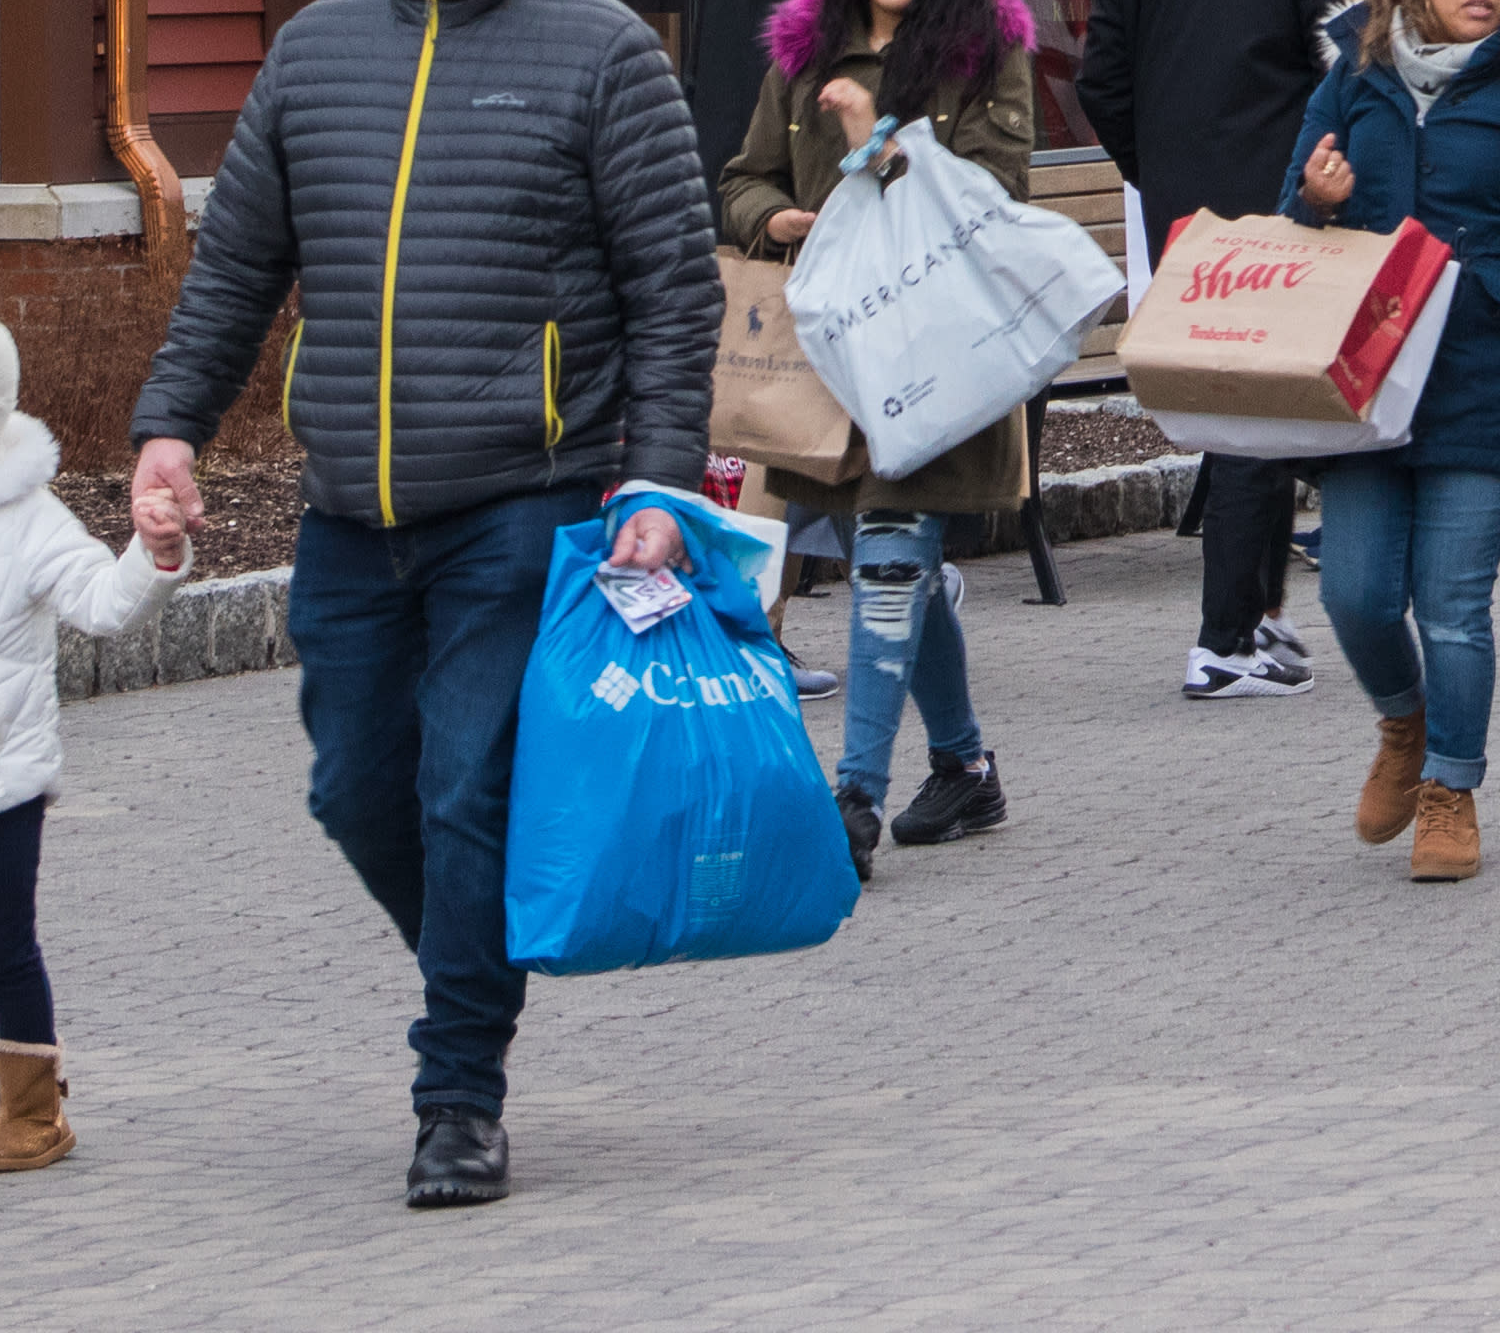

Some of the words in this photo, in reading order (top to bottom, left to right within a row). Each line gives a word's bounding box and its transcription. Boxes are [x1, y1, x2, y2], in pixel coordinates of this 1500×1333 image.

[1212, 236, 1310, 255] MOMENTS
[1319, 245, 1345, 256] TO
[1180, 247, 1317, 304] share
